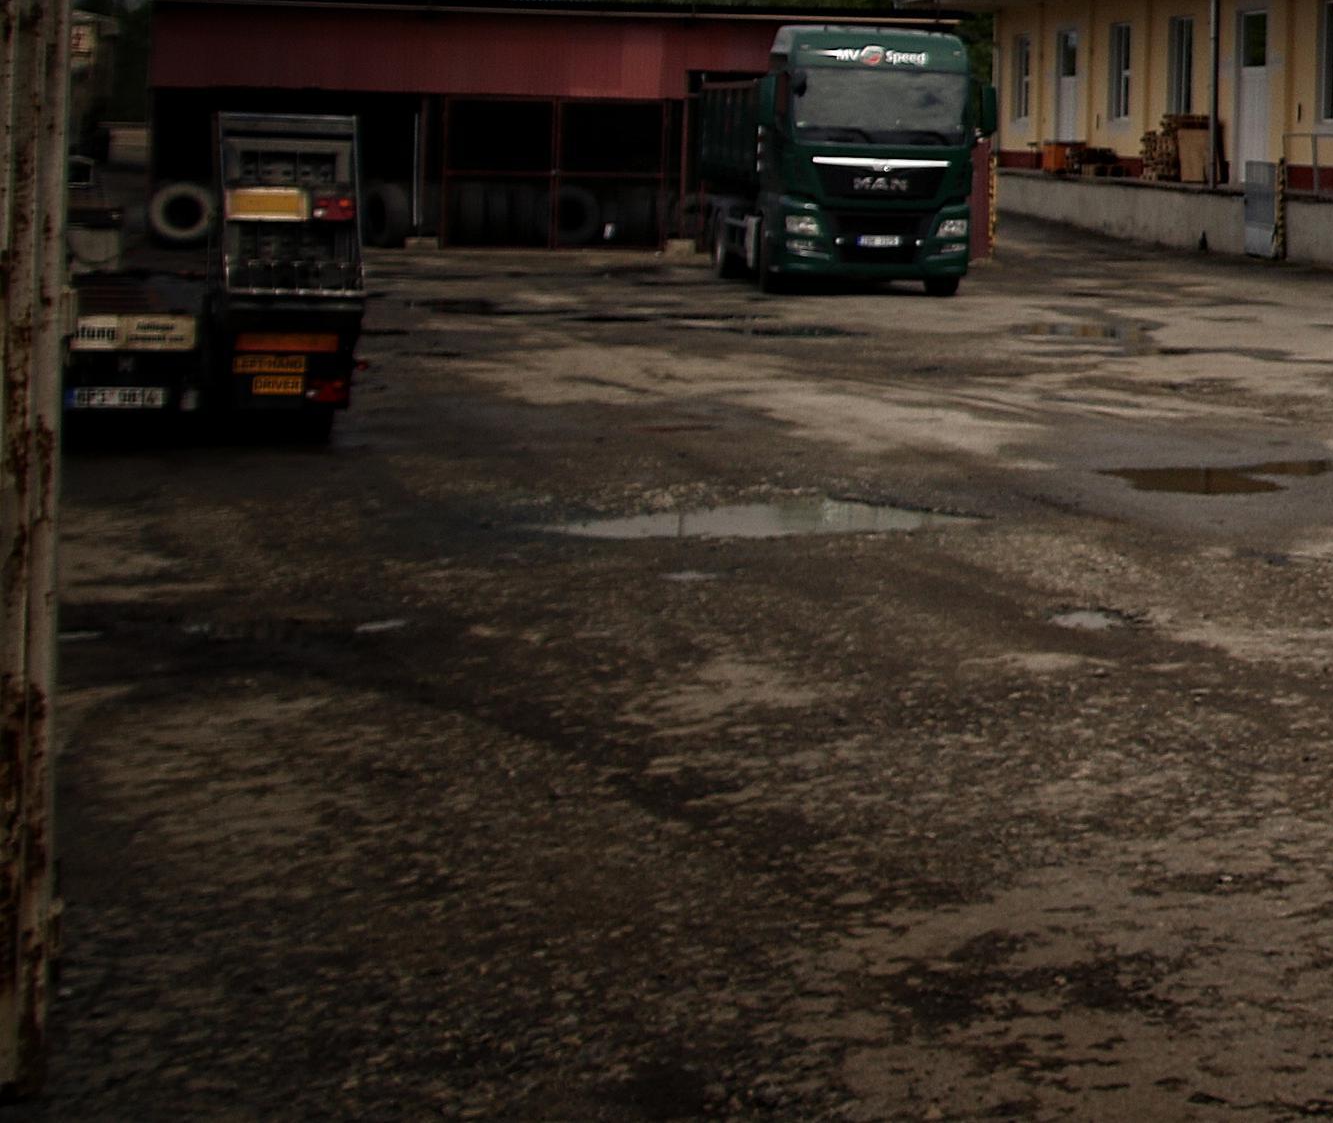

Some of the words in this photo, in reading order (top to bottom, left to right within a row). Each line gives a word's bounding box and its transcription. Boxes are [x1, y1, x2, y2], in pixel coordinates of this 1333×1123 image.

[885, 49, 927, 65] Speed
[853, 176, 909, 191] MAN
[73, 325, 116, 341] tung
